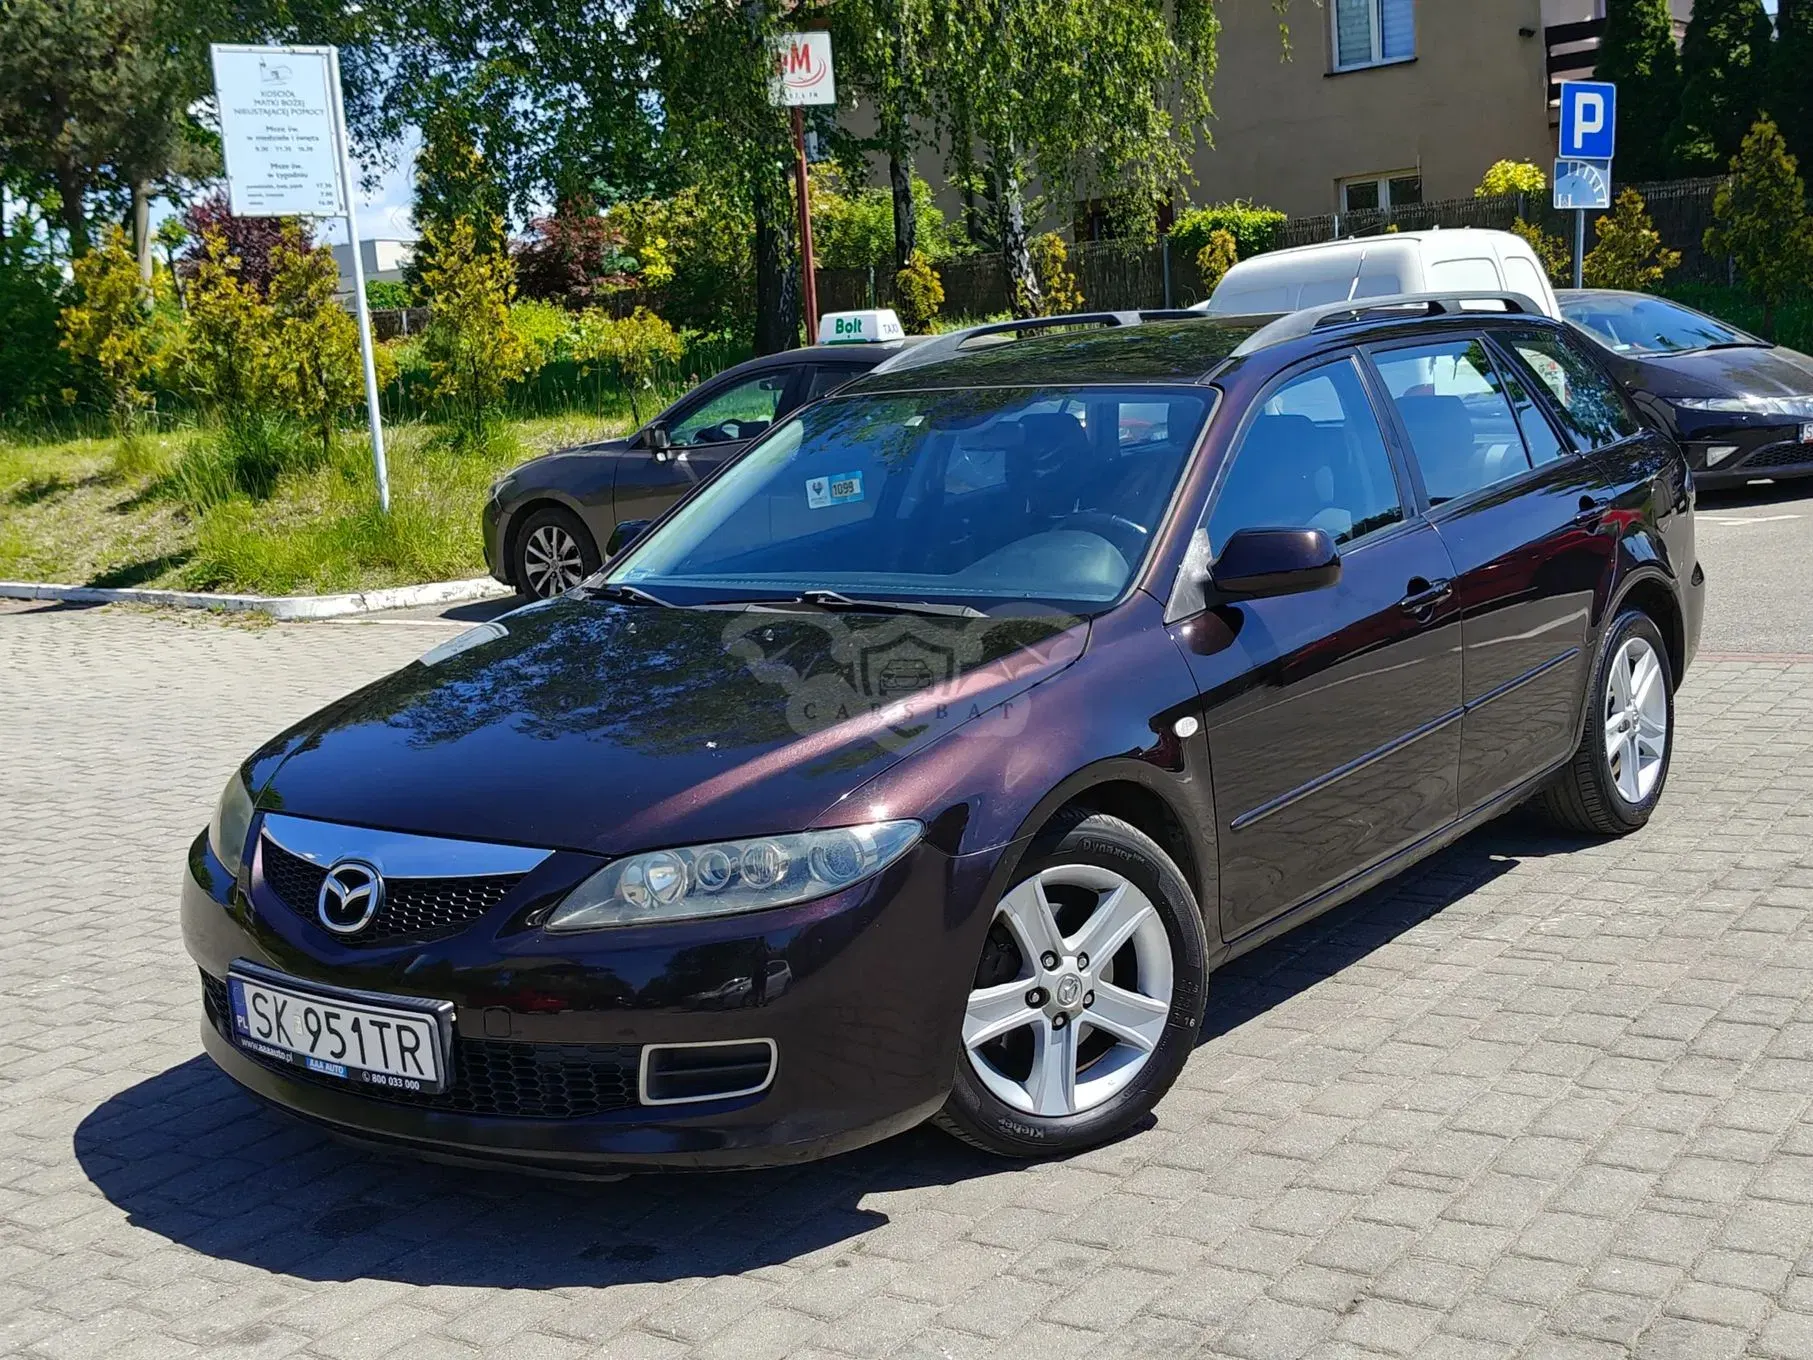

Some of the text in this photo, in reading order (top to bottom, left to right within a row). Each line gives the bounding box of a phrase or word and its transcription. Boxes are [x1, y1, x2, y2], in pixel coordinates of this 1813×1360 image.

[1573, 92, 1604, 149] P
[835, 318, 862, 334] Bolt
[883, 323, 899, 334] TAXI
[832, 481, 855, 496] 1099
[236, 1014, 249, 1030] PL
[252, 992, 425, 1076] SK 951TR
[309, 1058, 345, 1075] AAA AUTO
[371, 1074, 420, 1091] 800 033 000
